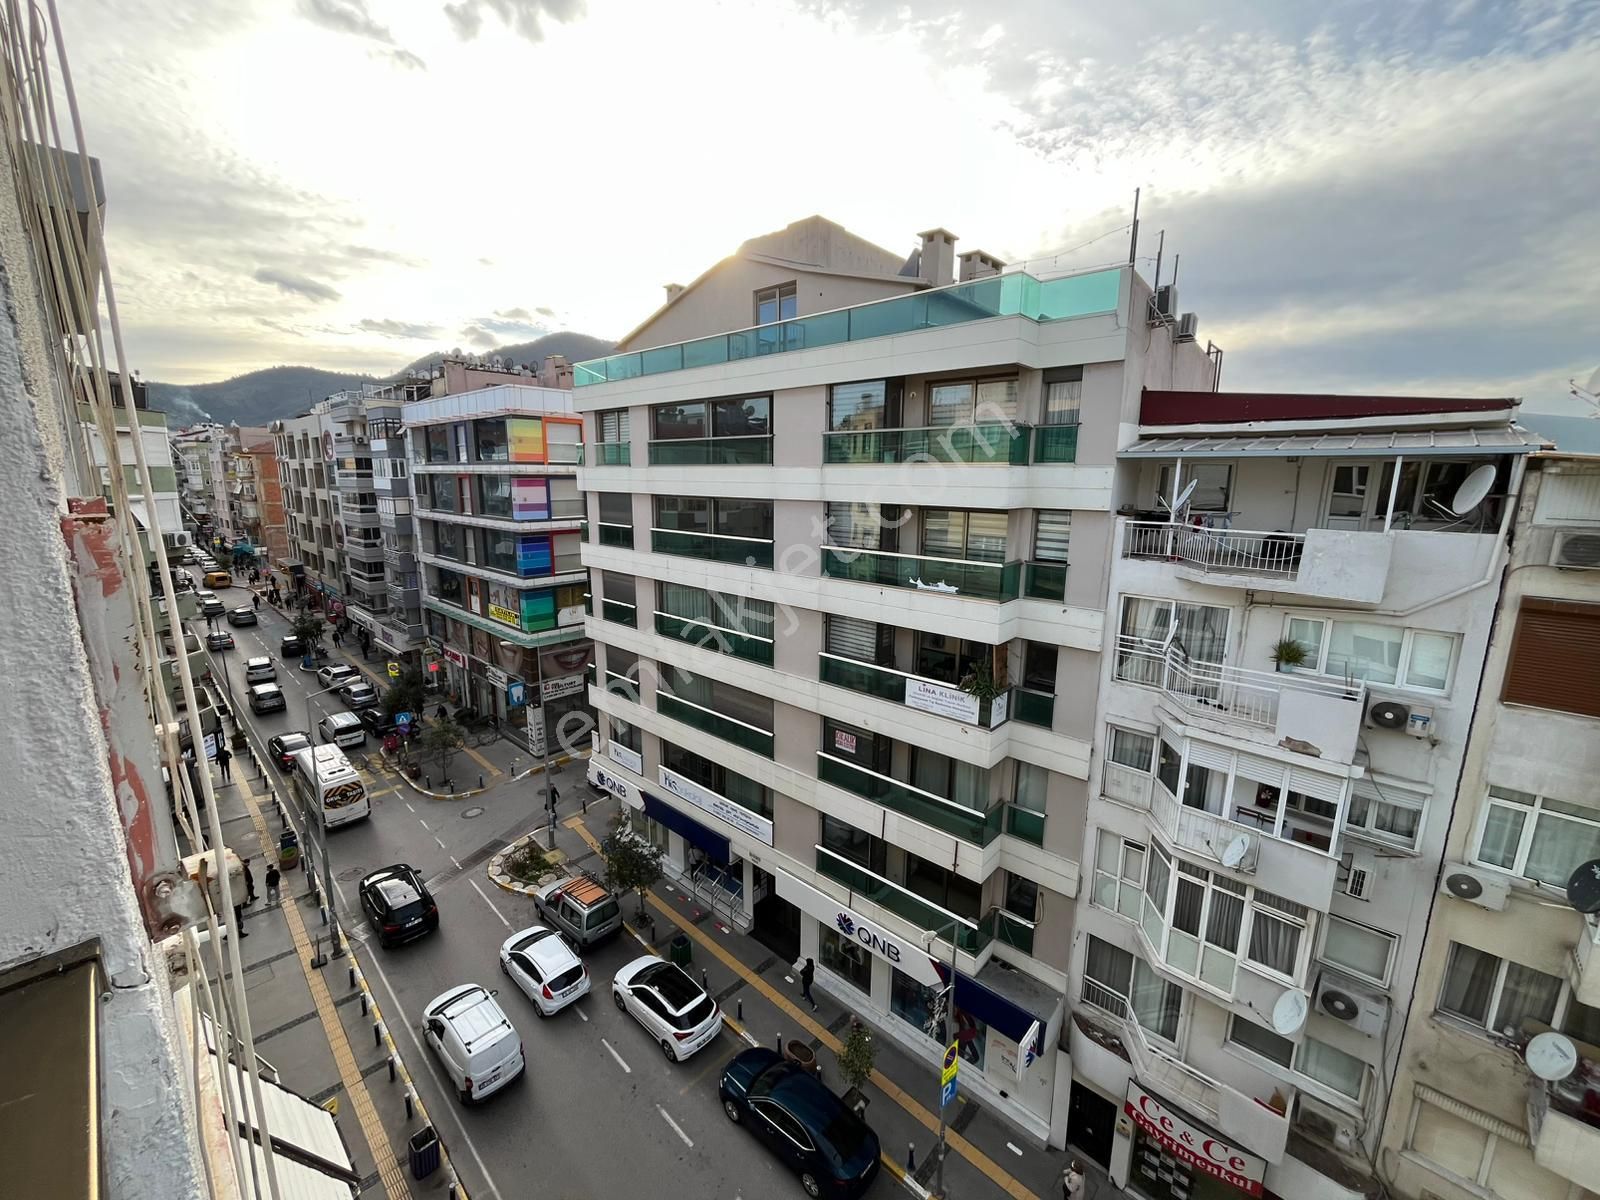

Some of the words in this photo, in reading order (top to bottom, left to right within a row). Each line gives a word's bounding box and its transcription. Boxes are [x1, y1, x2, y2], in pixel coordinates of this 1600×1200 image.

[606, 777, 627, 797] QNB
[857, 926, 900, 962] QNB
[942, 1082, 952, 1106] P
[1131, 1110, 1252, 1190] Gayrimenkul
[1140, 1095, 1174, 1132] Ce
[1180, 1131, 1194, 1146] &
[1202, 1139, 1246, 1171] Ce
